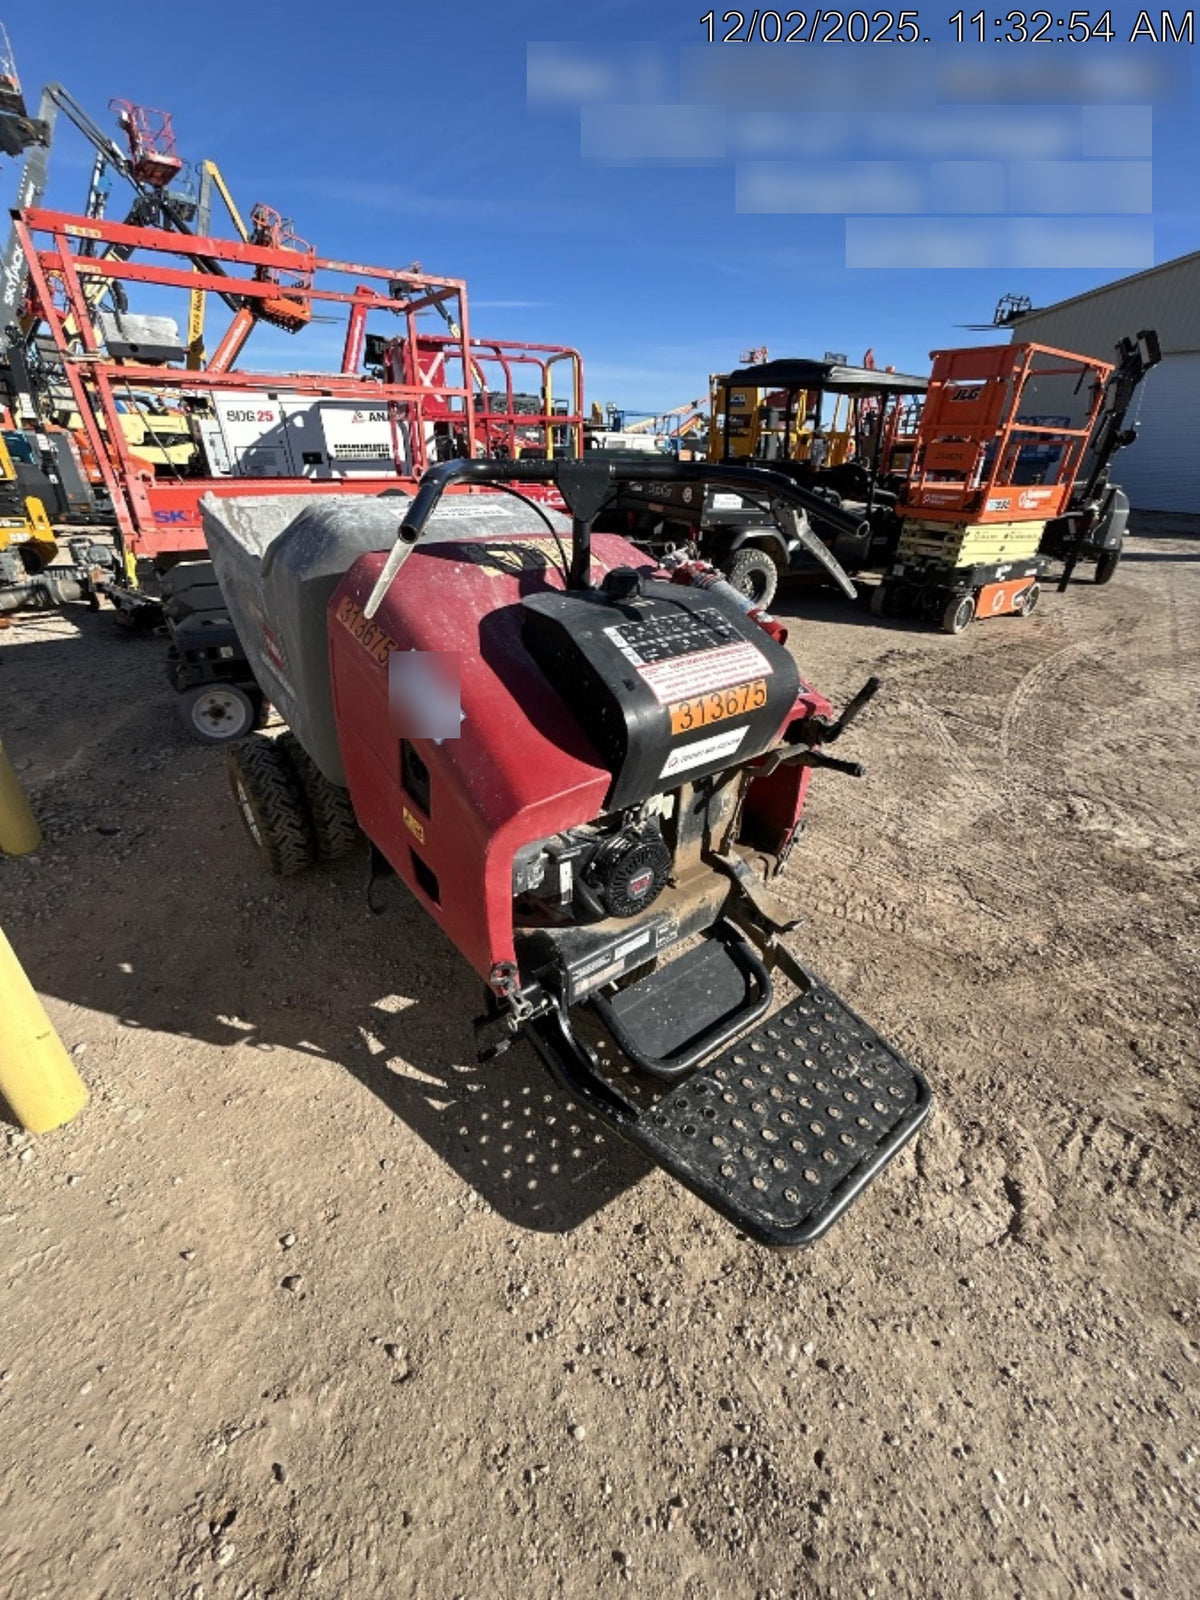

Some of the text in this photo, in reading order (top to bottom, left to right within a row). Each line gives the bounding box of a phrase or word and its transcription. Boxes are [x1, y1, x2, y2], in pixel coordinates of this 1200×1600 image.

[951, 388, 982, 400] JLG
[369, 411, 390, 422] AN
[339, 600, 397, 664] 313675
[679, 681, 766, 730] 313675
